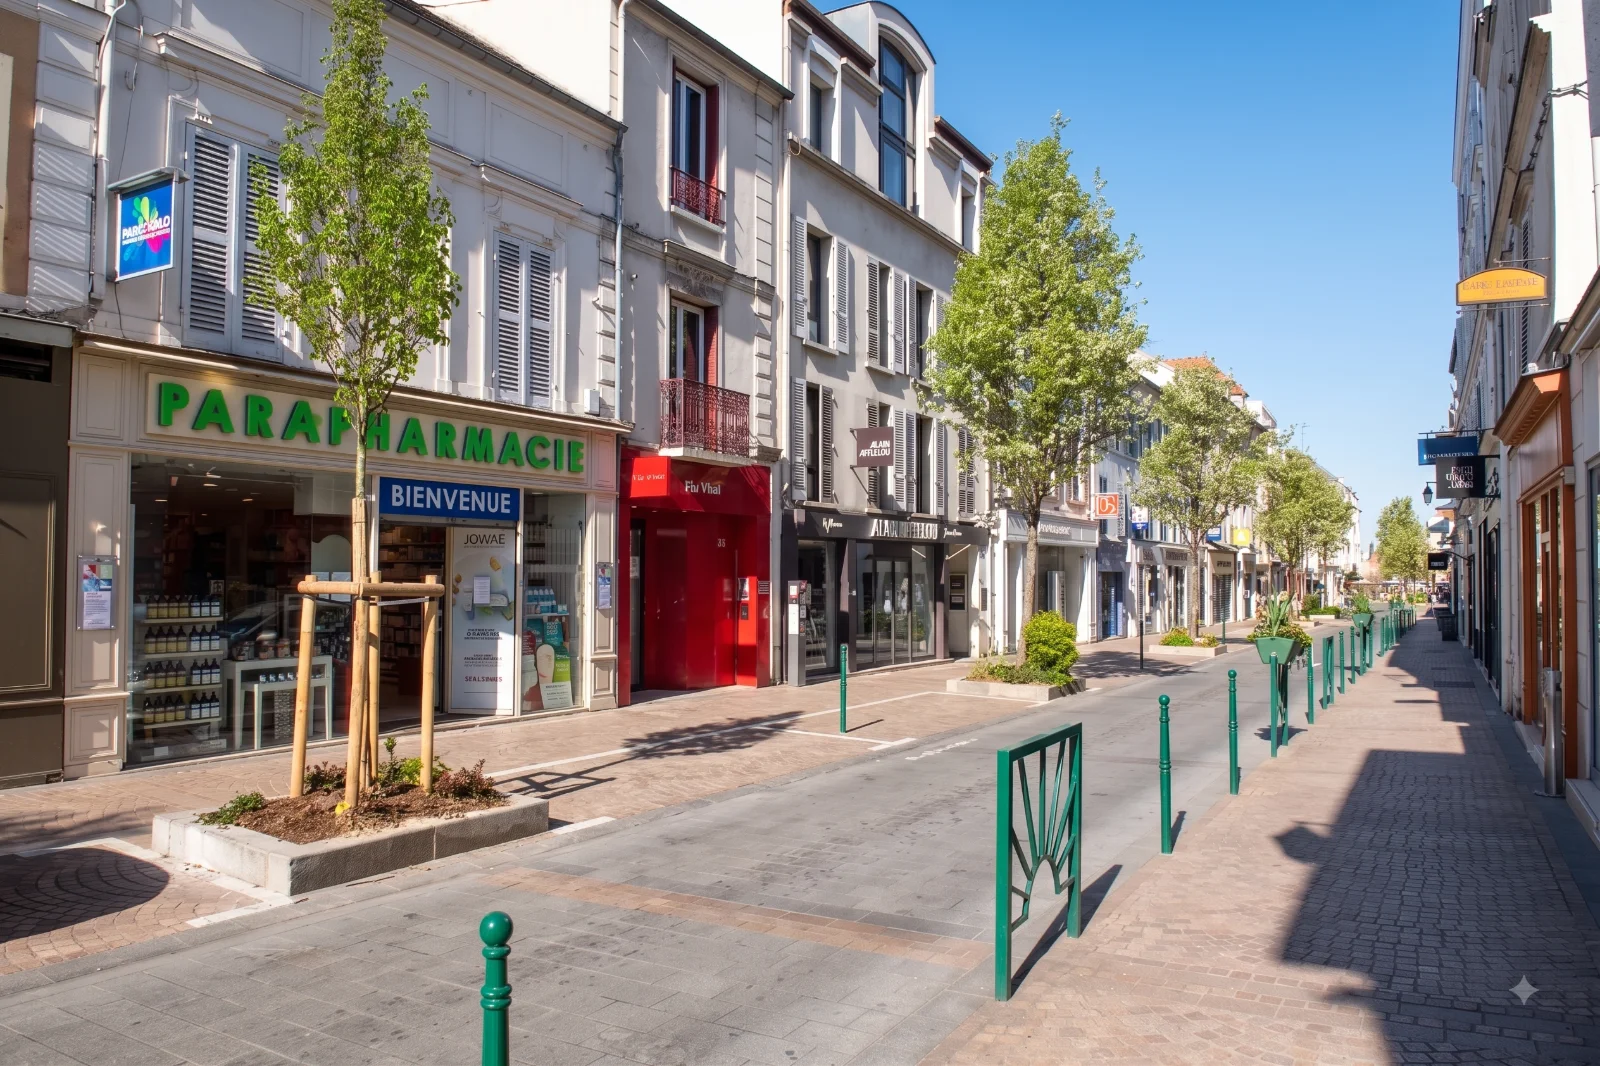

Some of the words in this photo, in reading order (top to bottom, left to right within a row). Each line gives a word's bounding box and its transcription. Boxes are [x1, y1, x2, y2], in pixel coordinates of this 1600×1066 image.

[158, 381, 584, 473] PARAPHARMACIE
[870, 440, 890, 449] ALAIN
[859, 448, 891, 457] AFFLELOU
[391, 484, 511, 514] BIENVENUE
[463, 533, 506, 545] JOWAE
